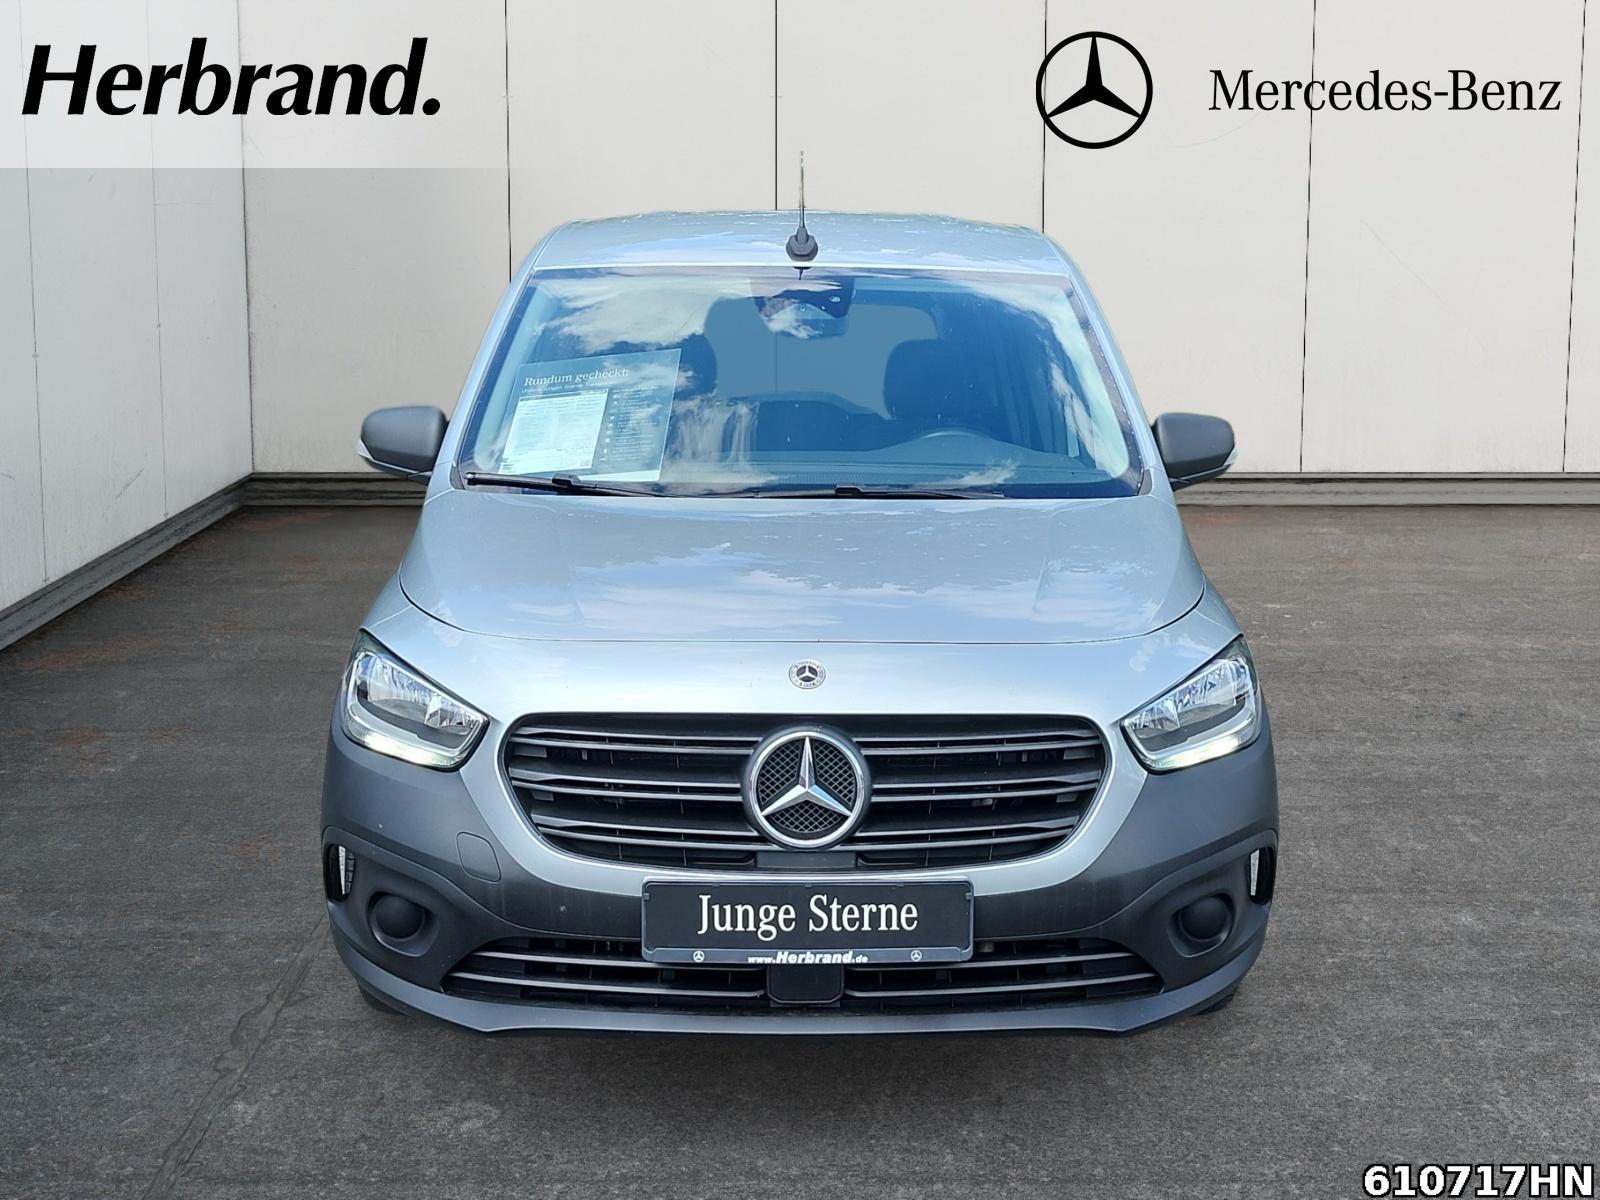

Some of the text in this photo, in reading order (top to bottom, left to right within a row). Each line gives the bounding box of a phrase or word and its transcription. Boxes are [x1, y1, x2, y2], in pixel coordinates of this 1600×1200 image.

[523, 374, 573, 387] Rundum
[697, 893, 918, 942] Junge Sterne
[747, 949, 869, 965] www.Herbrand.de
